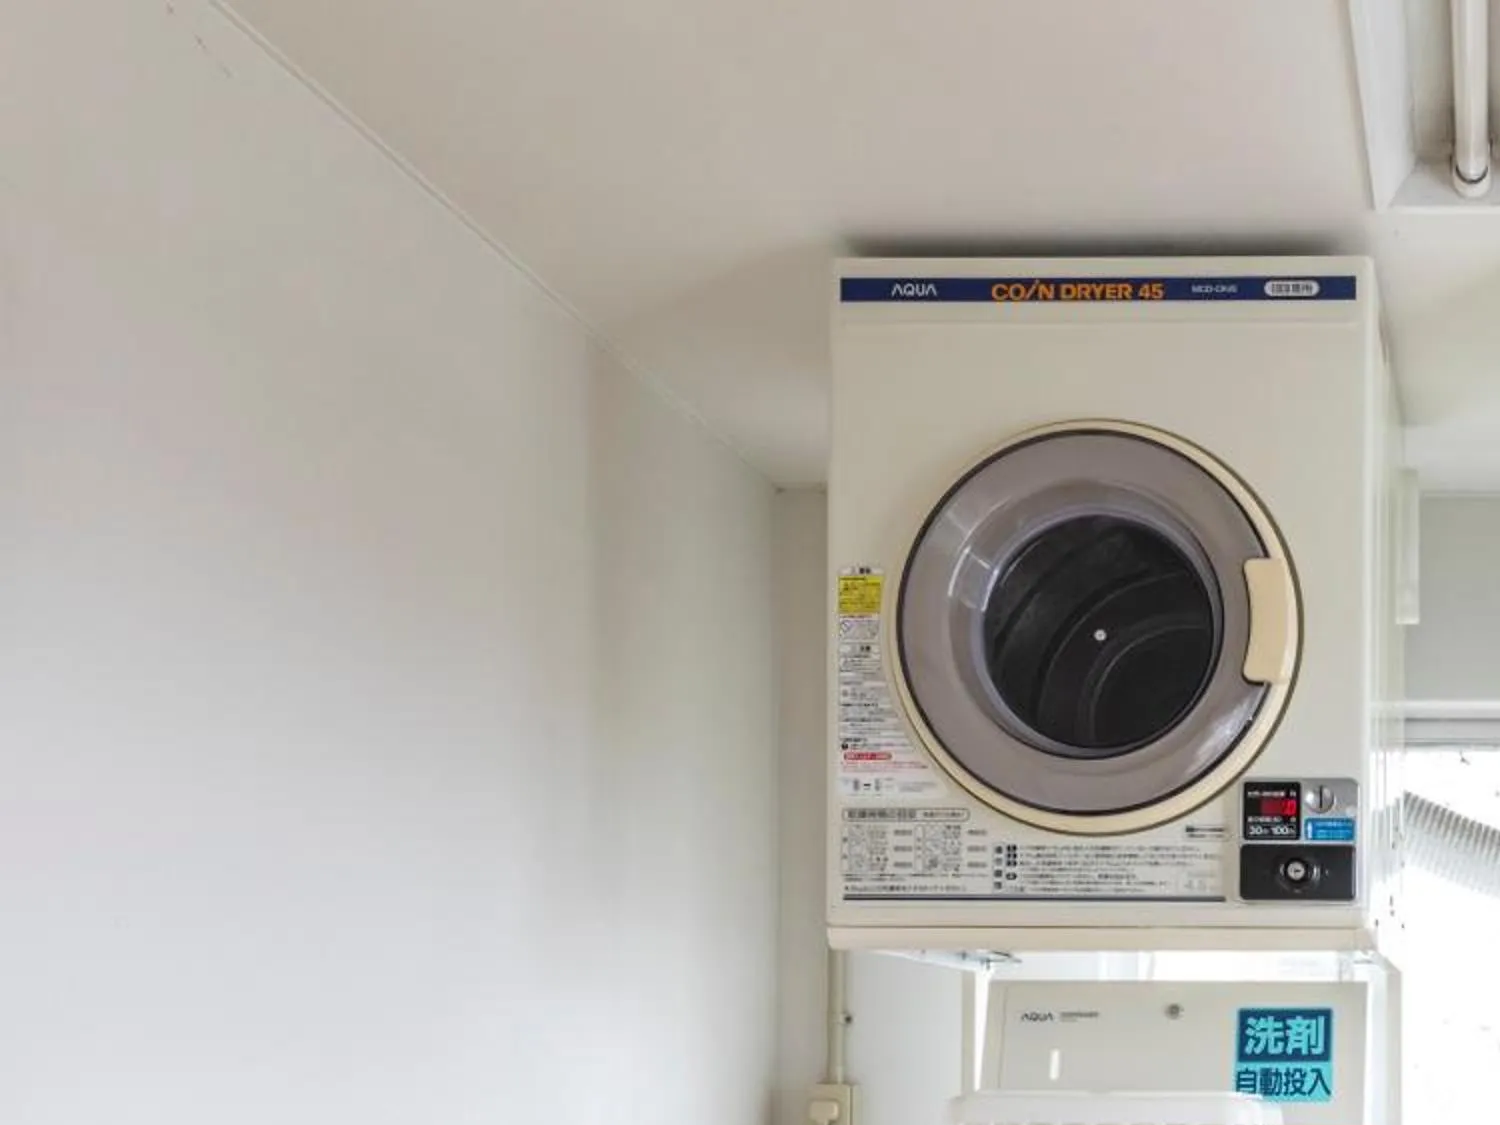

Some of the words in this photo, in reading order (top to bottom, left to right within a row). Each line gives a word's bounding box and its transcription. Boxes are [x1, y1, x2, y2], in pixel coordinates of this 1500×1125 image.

[892, 283, 937, 297] AQUA
[1060, 283, 1133, 299] DRYER
[1138, 283, 1165, 299] 45
[1021, 1012, 1054, 1022] AQUA
[1245, 1016, 1325, 1055] 洗剤
[1236, 1067, 1331, 1096] 自動投入
